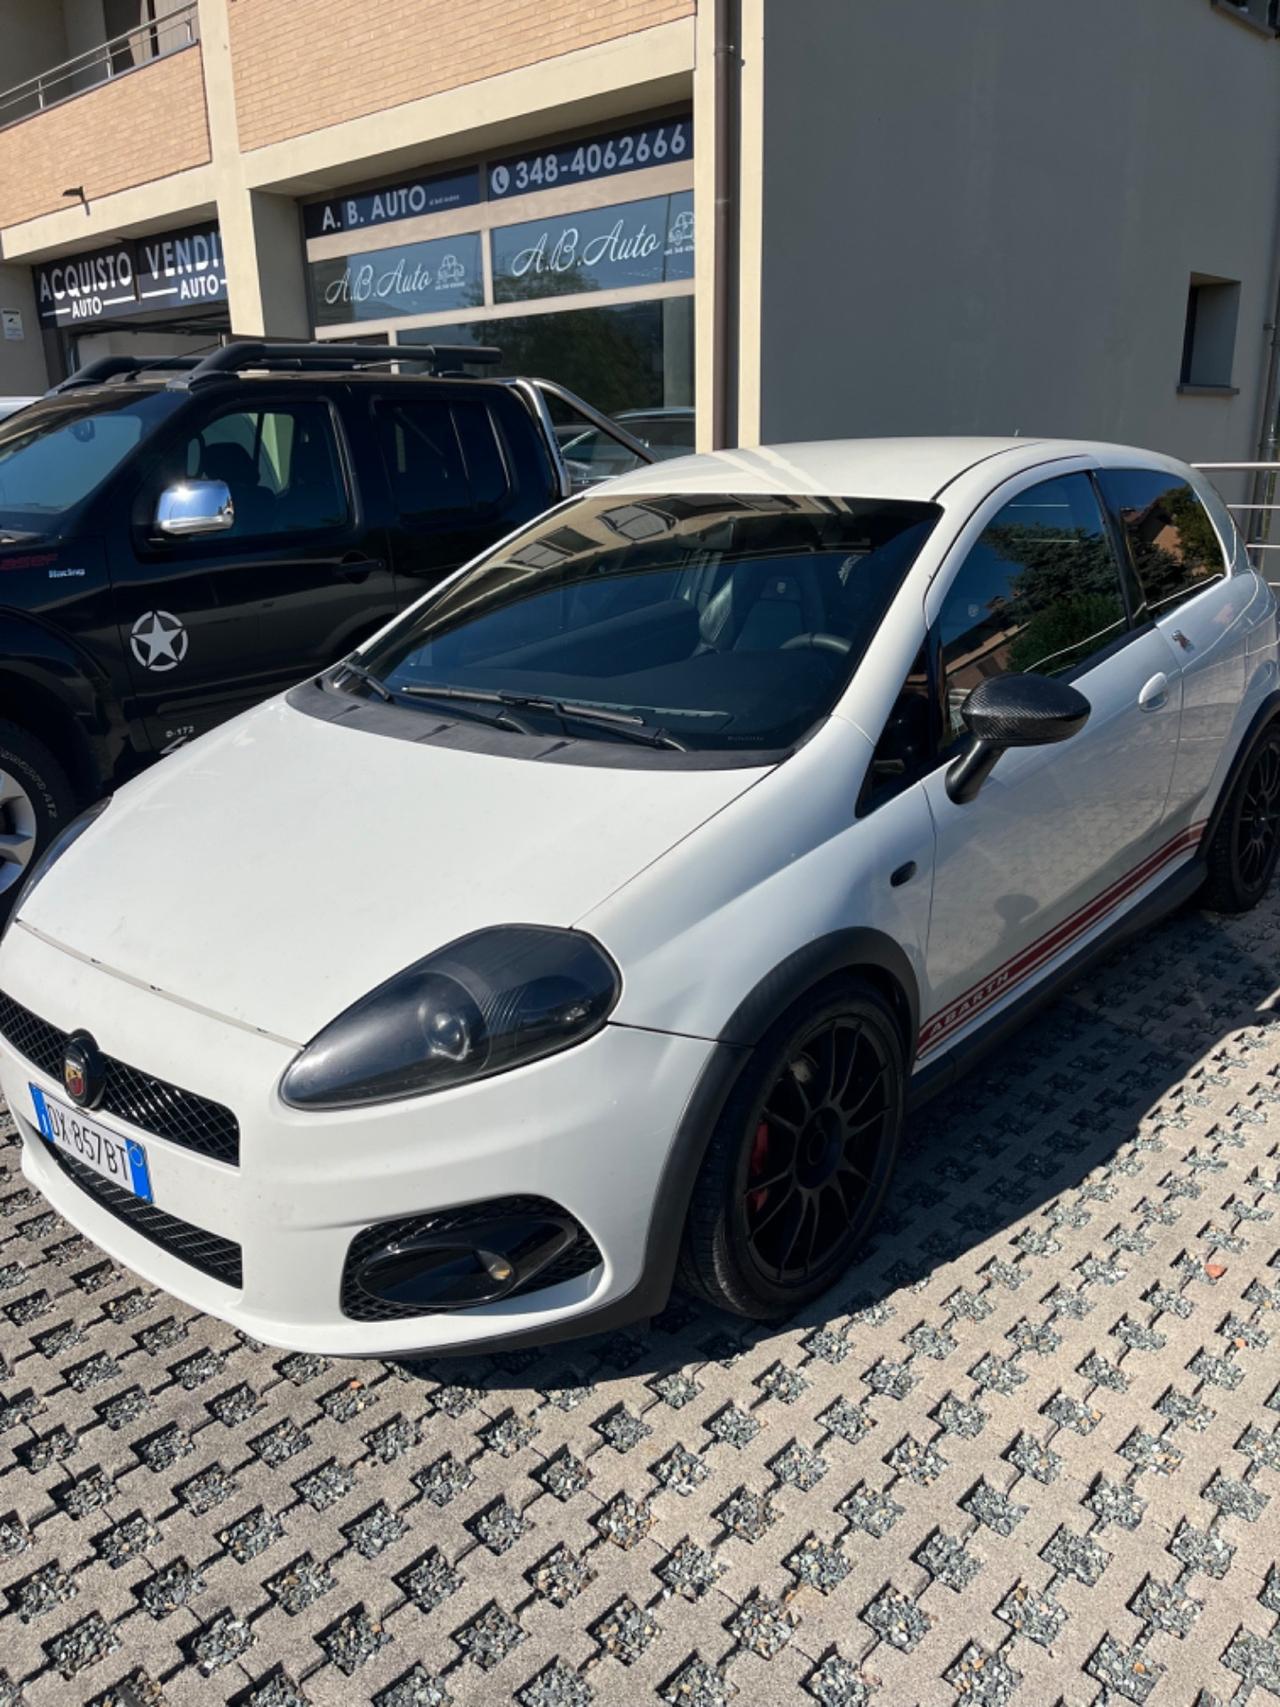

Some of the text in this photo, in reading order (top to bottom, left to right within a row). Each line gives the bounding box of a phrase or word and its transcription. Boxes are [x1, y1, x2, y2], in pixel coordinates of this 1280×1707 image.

[515, 124, 686, 189] 348-4062666
[322, 206, 342, 232] A.
[346, 201, 364, 225] B.
[371, 185, 426, 221] AUTO
[39, 252, 133, 303] ACQUISTO
[146, 231, 221, 280] VENDI
[72, 296, 103, 319] AUTO
[180, 275, 220, 300] AUTO
[929, 972, 1009, 1038] ABARTH
